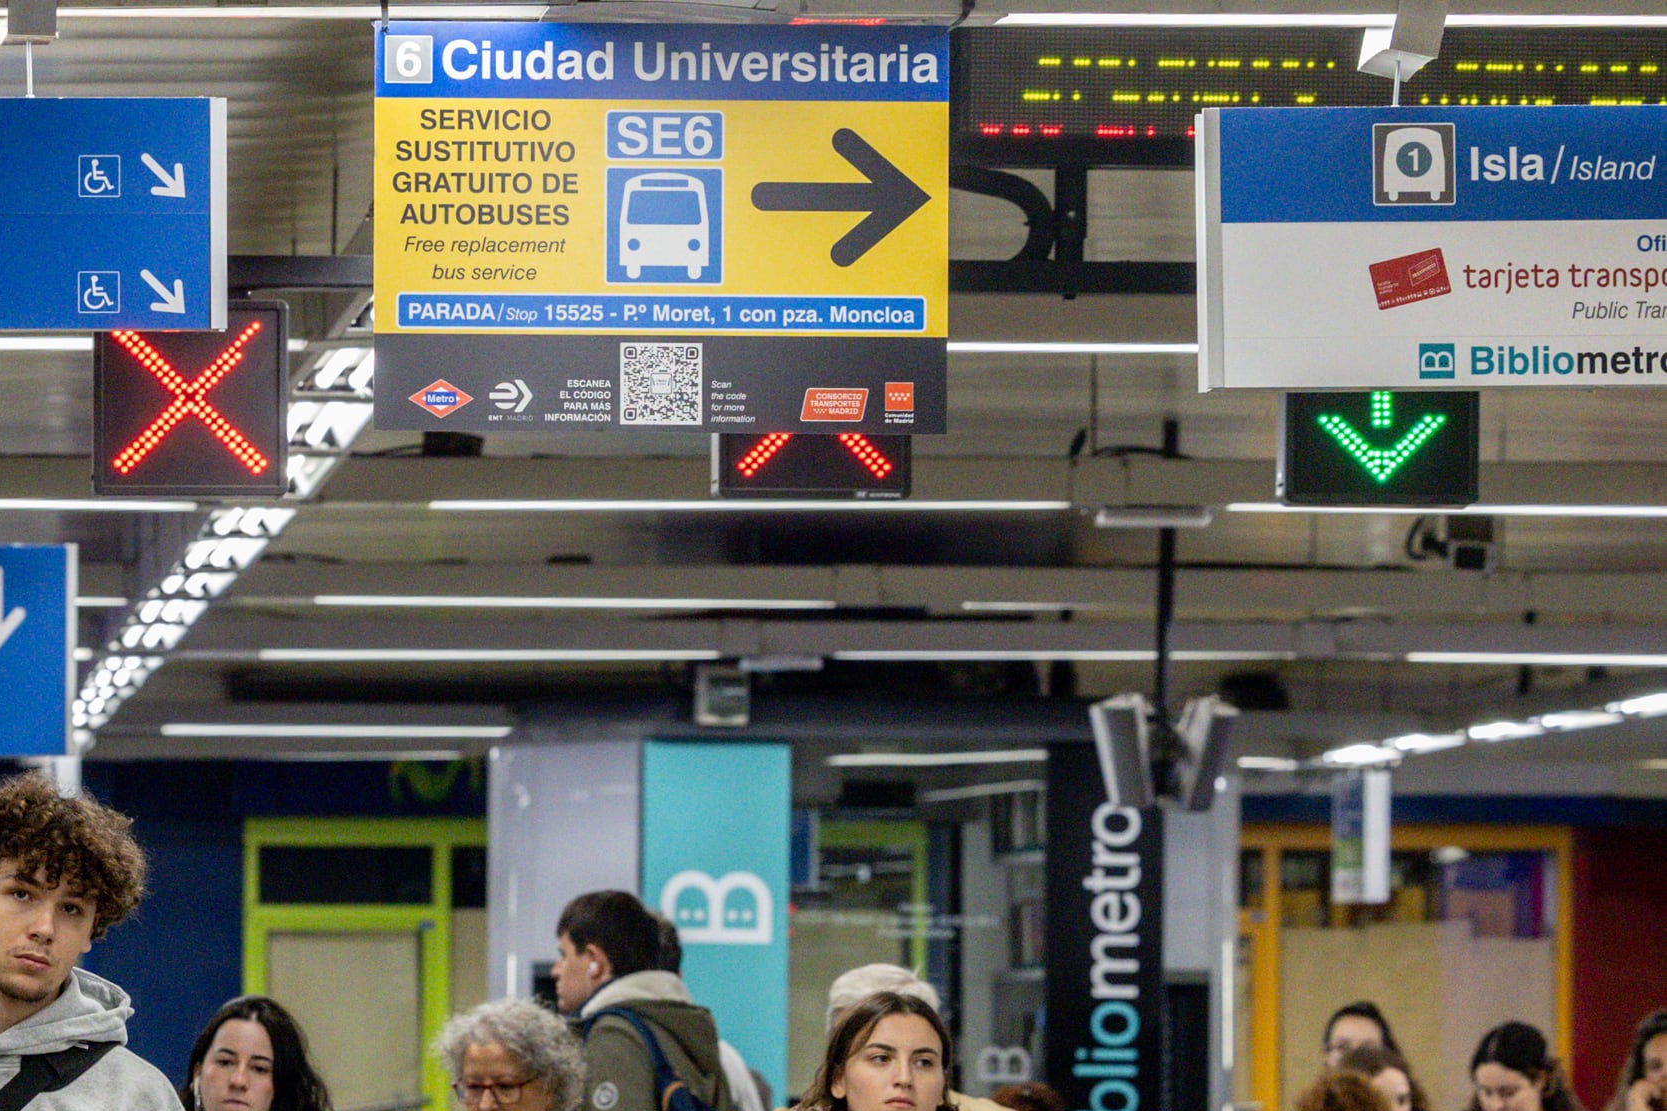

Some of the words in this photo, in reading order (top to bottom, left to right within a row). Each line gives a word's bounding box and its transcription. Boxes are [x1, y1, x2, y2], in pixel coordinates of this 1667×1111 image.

[396, 41, 421, 77] 6
[442, 39, 614, 81] Ciudad
[634, 42, 939, 83] Universitaria
[420, 109, 551, 131] SERVICIO
[617, 116, 713, 156] SE6
[396, 140, 575, 163] SUSTITUTIVO
[1408, 148, 1419, 171] 1
[1470, 146, 1545, 181] Isla
[1569, 155, 1656, 181] Island
[392, 171, 532, 194] GRATUITO
[543, 173, 579, 194] DE
[399, 203, 570, 226] AUTOBUSES
[404, 236, 445, 252] Free
[450, 236, 566, 256] replacement
[432, 264, 466, 280] bus
[471, 264, 537, 280] service
[1463, 262, 1559, 294] tarjeta
[544, 304, 604, 321] 15525
[653, 304, 715, 325] Moret,
[722, 305, 731, 322] 1
[740, 309, 776, 322] con
[783, 309, 823, 327] pza.
[830, 306, 914, 323] Moncloa
[1572, 301, 1629, 319] Public
[567, 379, 611, 388] ESCANEA
[711, 380, 732, 389] Scan
[427, 394, 455, 403] Metro
[559, 390, 572, 399] EL
[573, 389, 611, 399] CÓDIGO
[711, 392, 724, 400] the
[726, 392, 747, 400] code
[563, 402, 589, 410] PARA
[590, 400, 611, 411] MÁS
[711, 403, 723, 411] for
[723, 404, 745, 412] more
[544, 411, 611, 422] INFORMACIÓN
[710, 414, 756, 423] information
